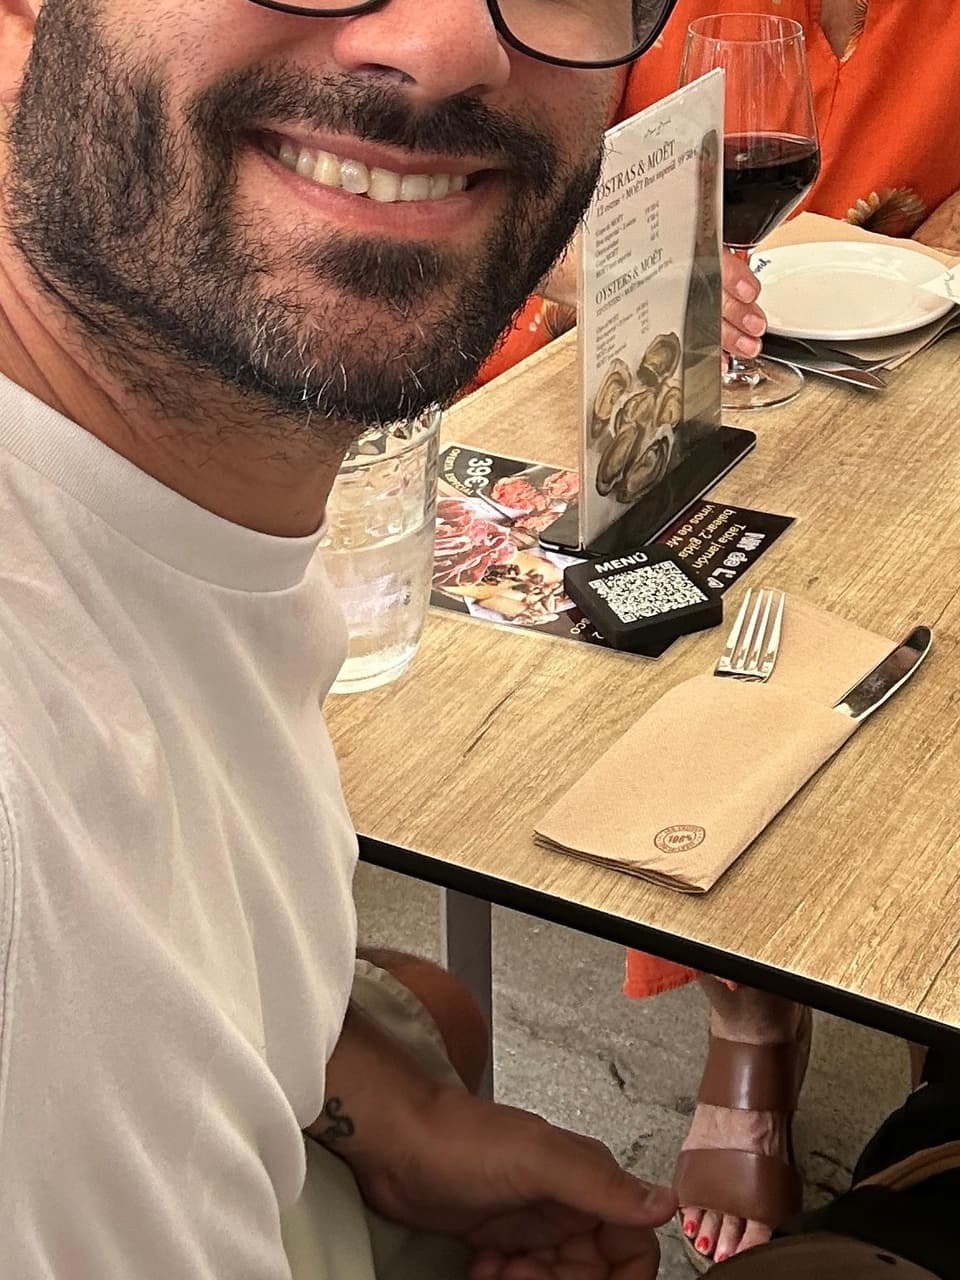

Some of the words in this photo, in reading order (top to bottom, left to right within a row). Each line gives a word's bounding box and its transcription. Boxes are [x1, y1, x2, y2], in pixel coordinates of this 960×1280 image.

[597, 162, 636, 201] OSTRAS
[647, 139, 676, 170] MOËT
[464, 457, 494, 489] 39€
[594, 551, 648, 574] MENÚ
